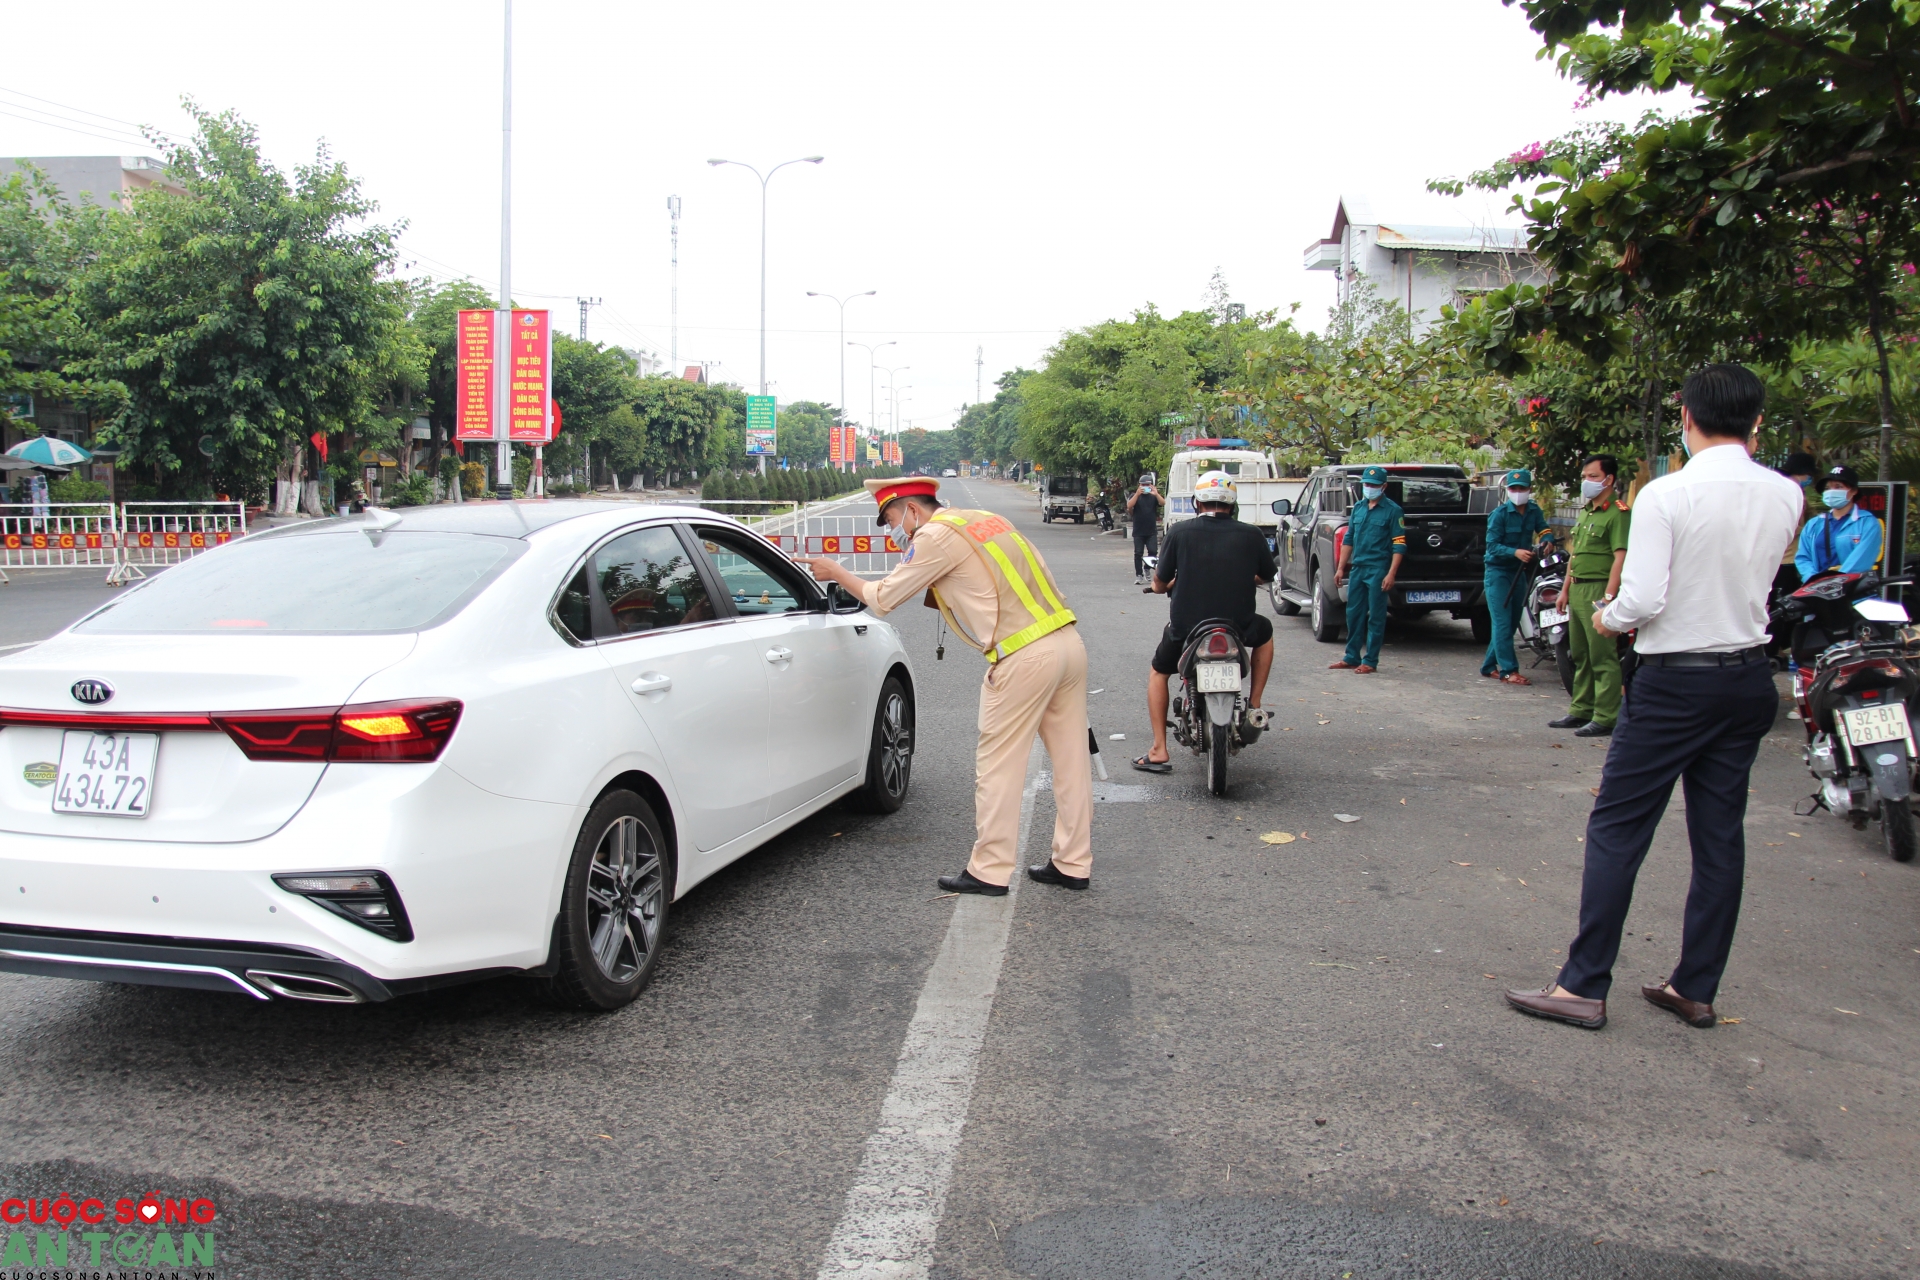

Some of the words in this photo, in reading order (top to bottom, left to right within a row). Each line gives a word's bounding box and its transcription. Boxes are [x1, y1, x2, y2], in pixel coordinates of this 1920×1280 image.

[966, 515, 1012, 543] CSGT
[1204, 666, 1233, 677] 37-N8
[75, 684, 106, 700] KIA
[1204, 678, 1235, 690] 8462
[1856, 708, 1896, 726] 92-B1
[1854, 722, 1904, 742] 281.47
[82, 735, 130, 772] 43A
[58, 772, 146, 812] 434.72
